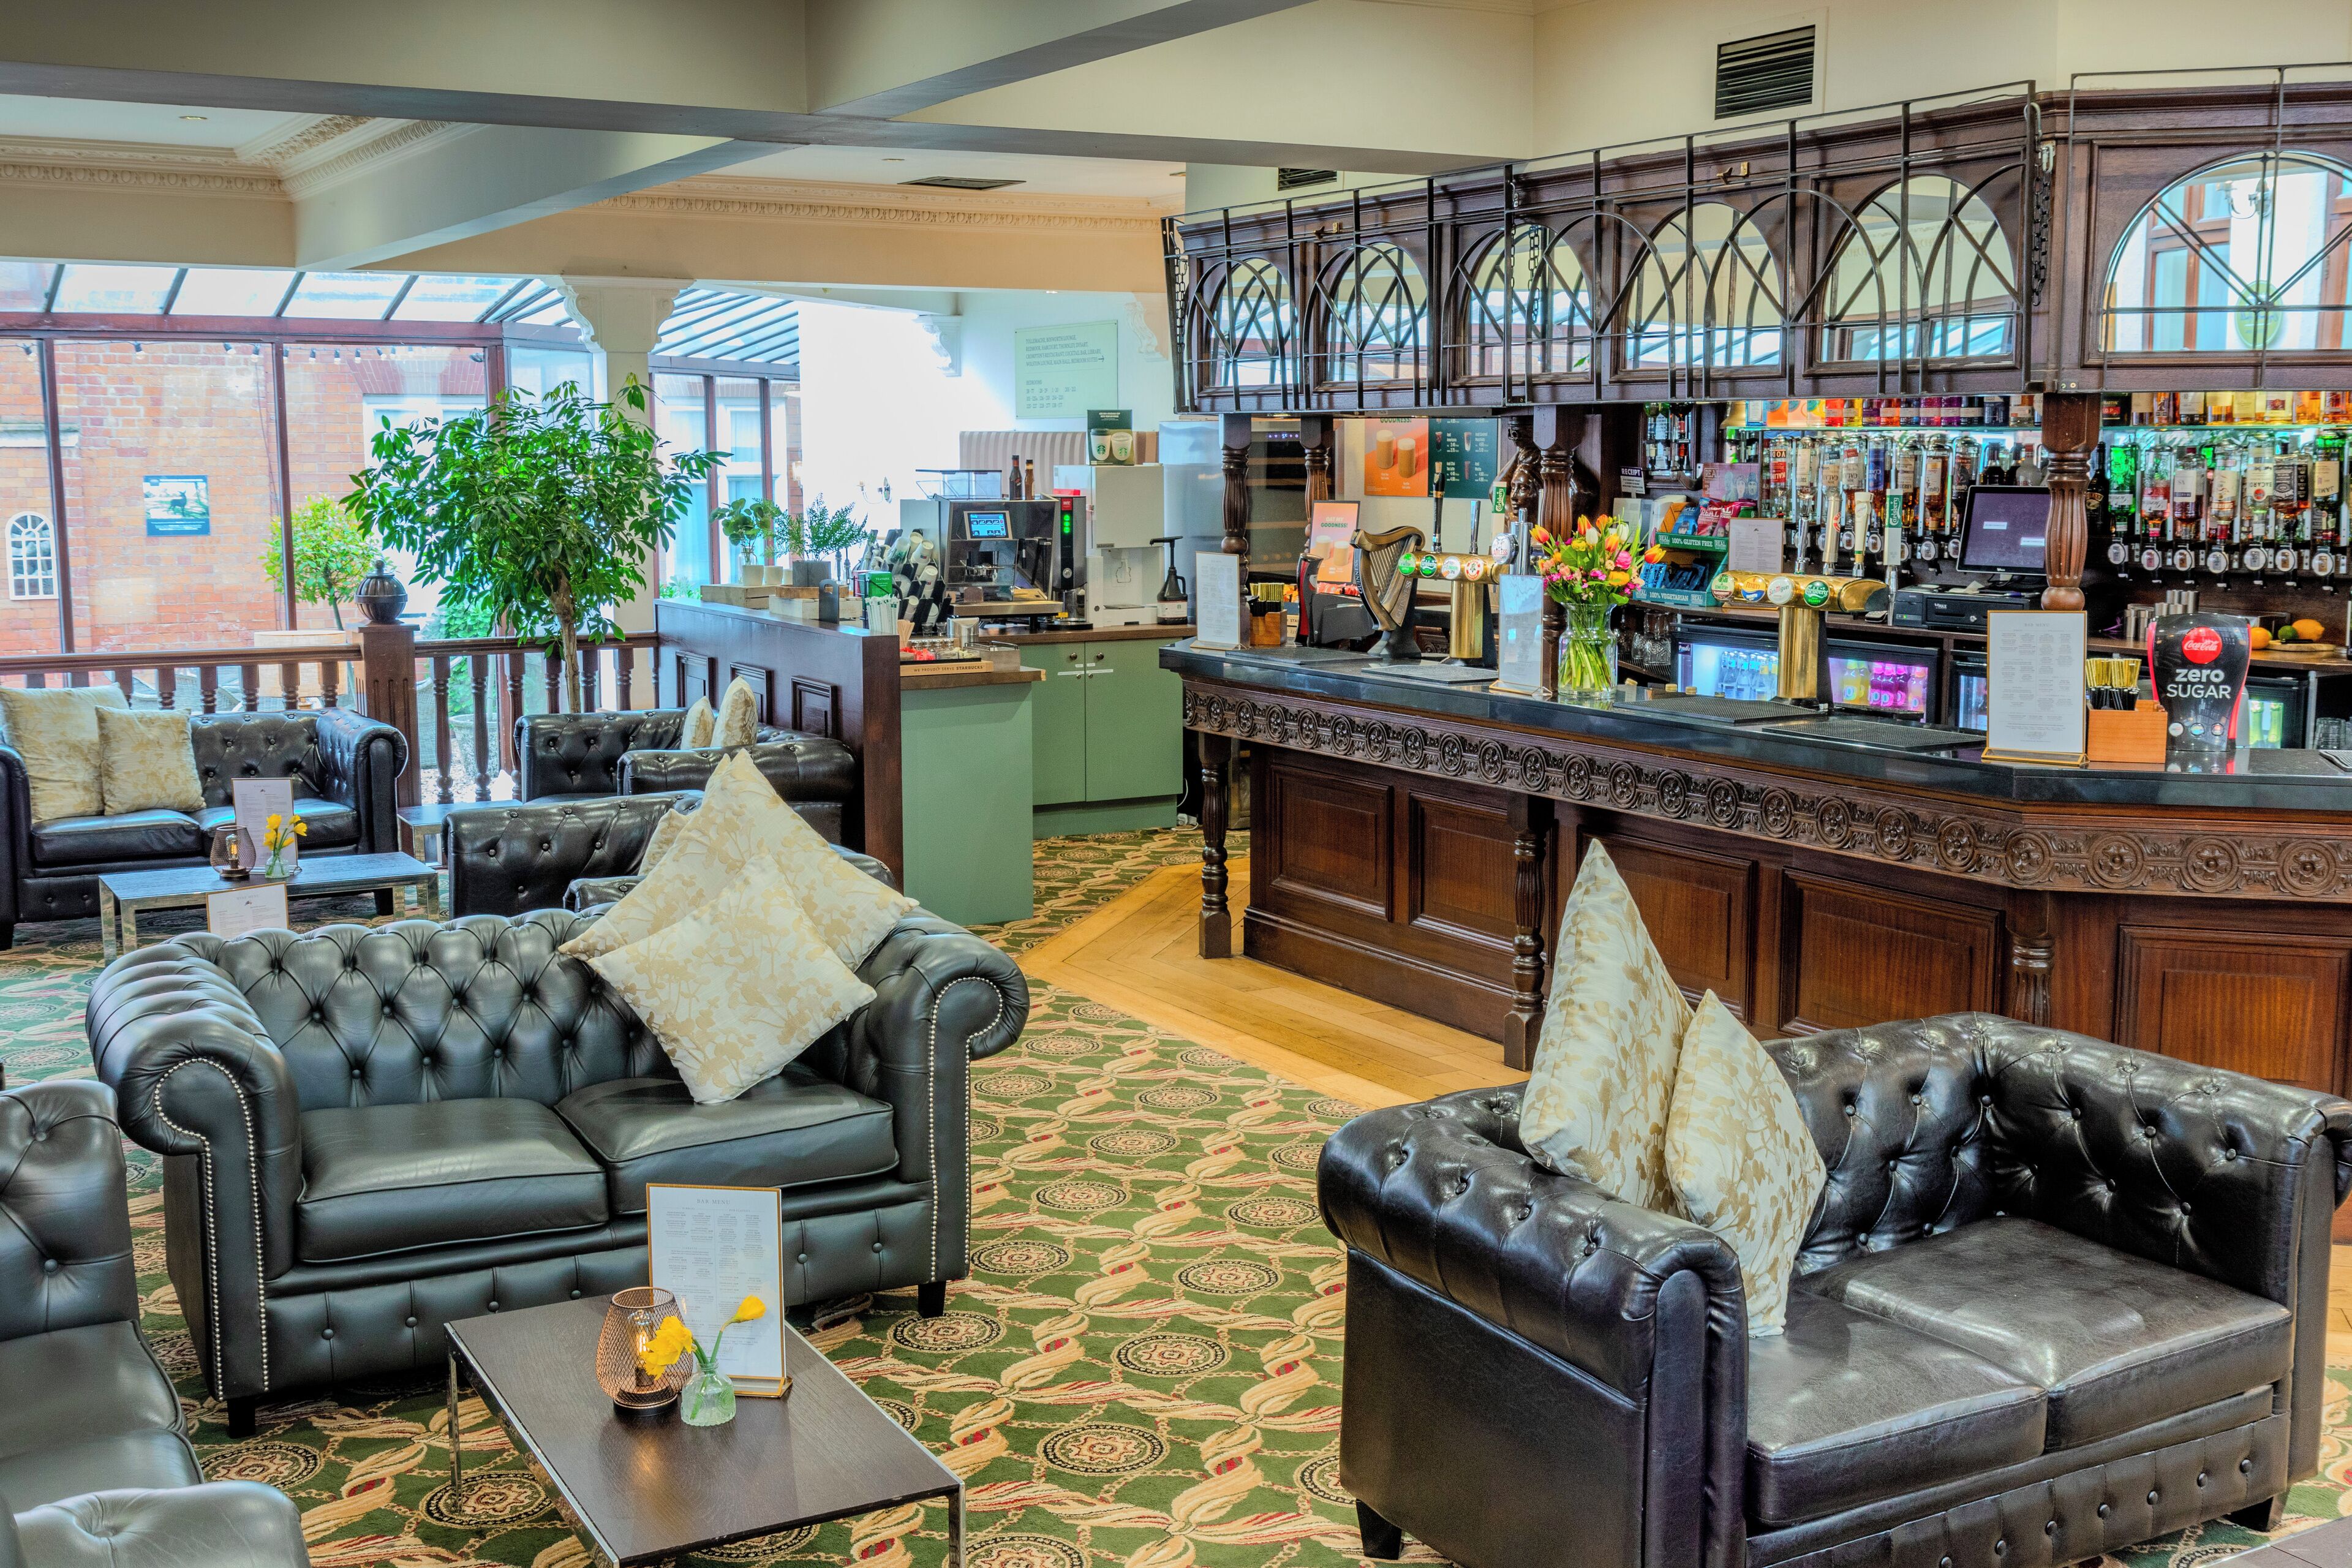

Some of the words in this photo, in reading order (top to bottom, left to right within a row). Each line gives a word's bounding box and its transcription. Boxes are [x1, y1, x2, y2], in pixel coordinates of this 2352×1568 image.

[1700, 508, 1719, 518] REAL
[1890, 497, 1900, 526] Carlsberg
[1354, 559, 1363, 594] GUINNESS
[1661, 593, 1689, 601] VEGETARIAN
[1806, 585, 1829, 598] Carlsberg
[1395, 580, 1412, 619] GUINNESS
[2184, 639, 2219, 651] Coca-Cola
[2175, 668, 2225, 682] zero
[2166, 684, 2231, 699] SUGAR
